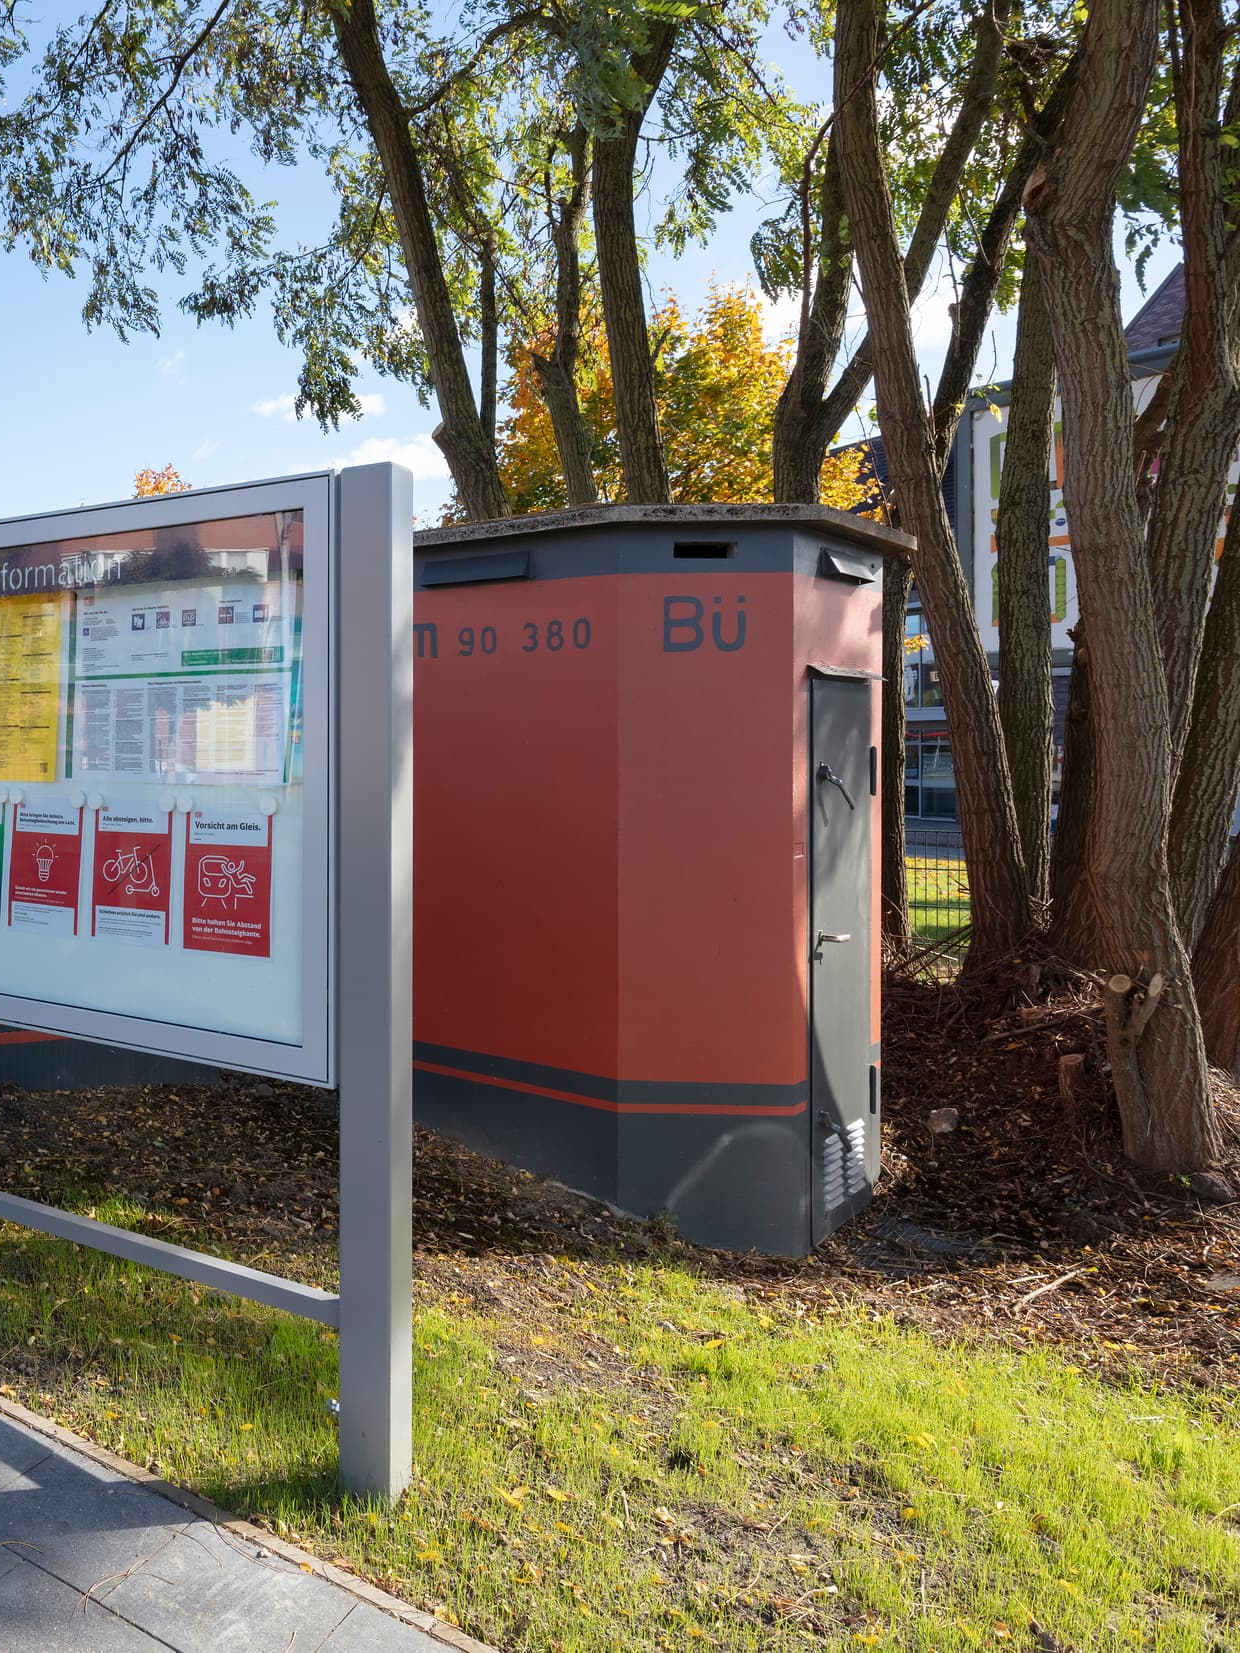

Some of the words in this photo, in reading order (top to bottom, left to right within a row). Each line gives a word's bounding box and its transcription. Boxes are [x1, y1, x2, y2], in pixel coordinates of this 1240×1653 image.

[663, 595, 747, 653] Bü
[413, 623, 439, 659] m
[458, 626, 498, 657] 90
[521, 617, 592, 653] 380
[194, 821, 225, 830] Vorsicht
[226, 823, 238, 831] am
[239, 822, 262, 831] Gleis.
[191, 917, 206, 925] Bitte
[207, 918, 226, 927] halten
[226, 919, 236, 927] Sie
[236, 921, 262, 929] Abstand
[203, 926, 214, 934] der
[214, 927, 262, 938] Bahnsteigkante.
